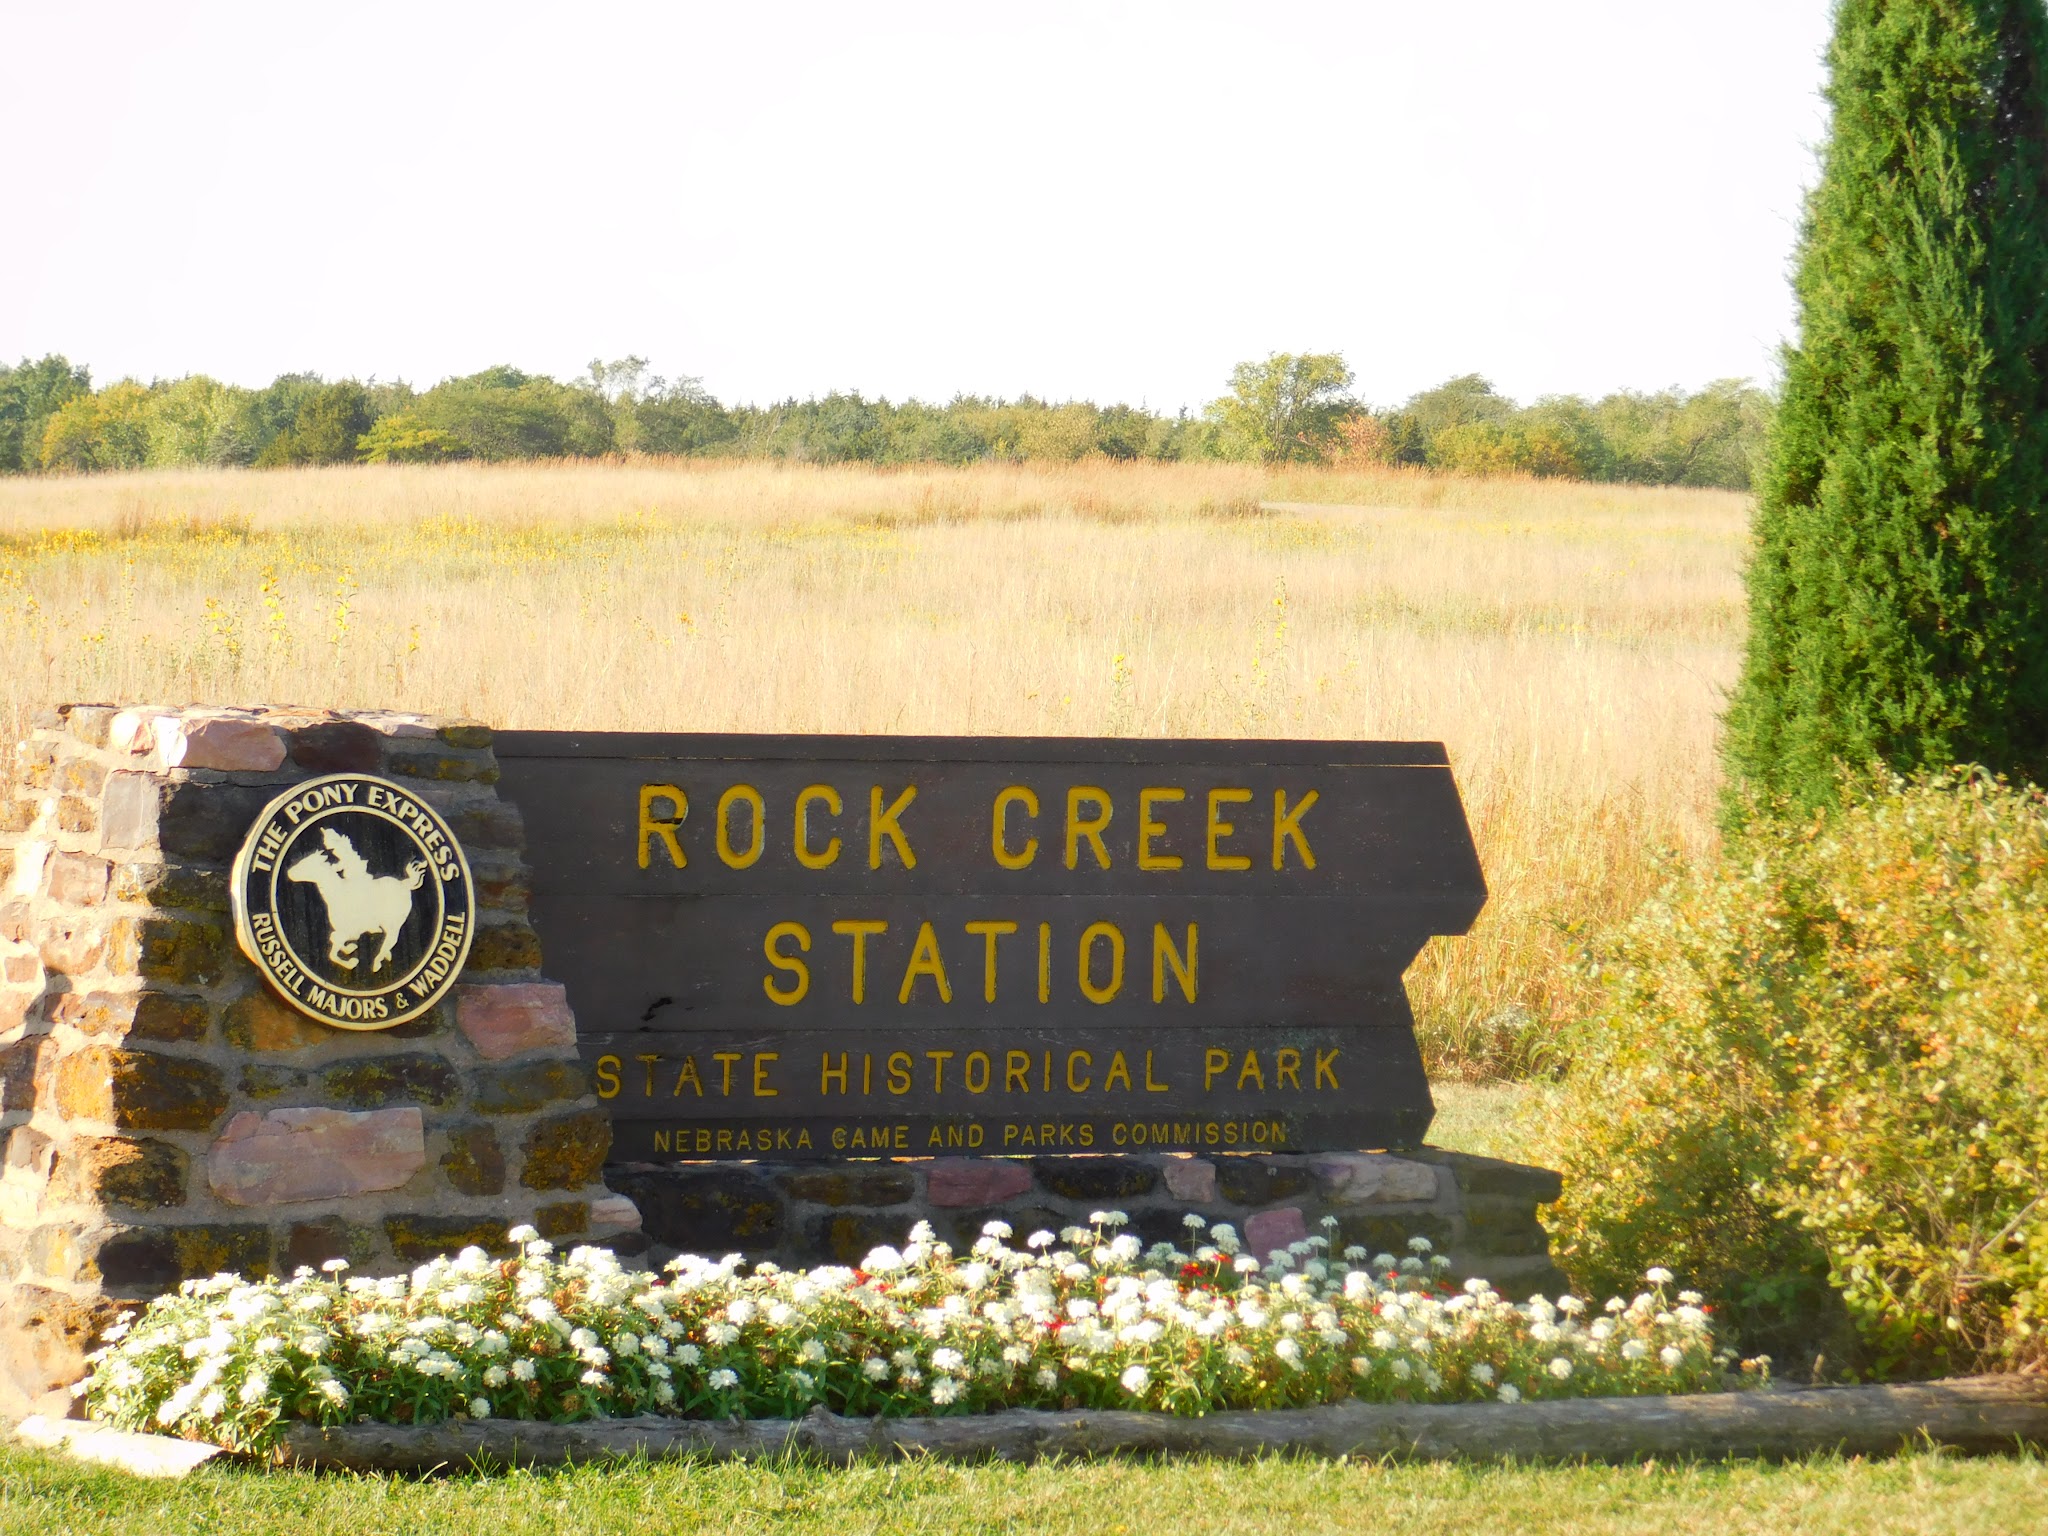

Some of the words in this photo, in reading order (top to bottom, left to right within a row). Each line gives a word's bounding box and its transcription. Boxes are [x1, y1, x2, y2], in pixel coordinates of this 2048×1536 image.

[253, 821, 287, 874] THE
[285, 783, 358, 825] PONY
[368, 785, 460, 882] EXPRESS
[637, 783, 919, 870] ROCK
[993, 785, 1320, 871] CREEK
[252, 912, 307, 996] RUSSELL
[308, 986, 389, 1019] MAJORS
[395, 992, 410, 1010] &
[408, 911, 465, 998] WADDELL
[763, 920, 1199, 1005] STATION
[597, 1052, 779, 1098] STATE
[821, 1049, 1169, 1095] HISTORICAL
[1204, 1048, 1340, 1092] PARK
[654, 1128, 813, 1153] NEBRASKA
[832, 1125, 910, 1150] GAME
[928, 1123, 984, 1148] AND
[1004, 1123, 1094, 1147] PARKS
[1112, 1120, 1287, 1146] COMMISSION
